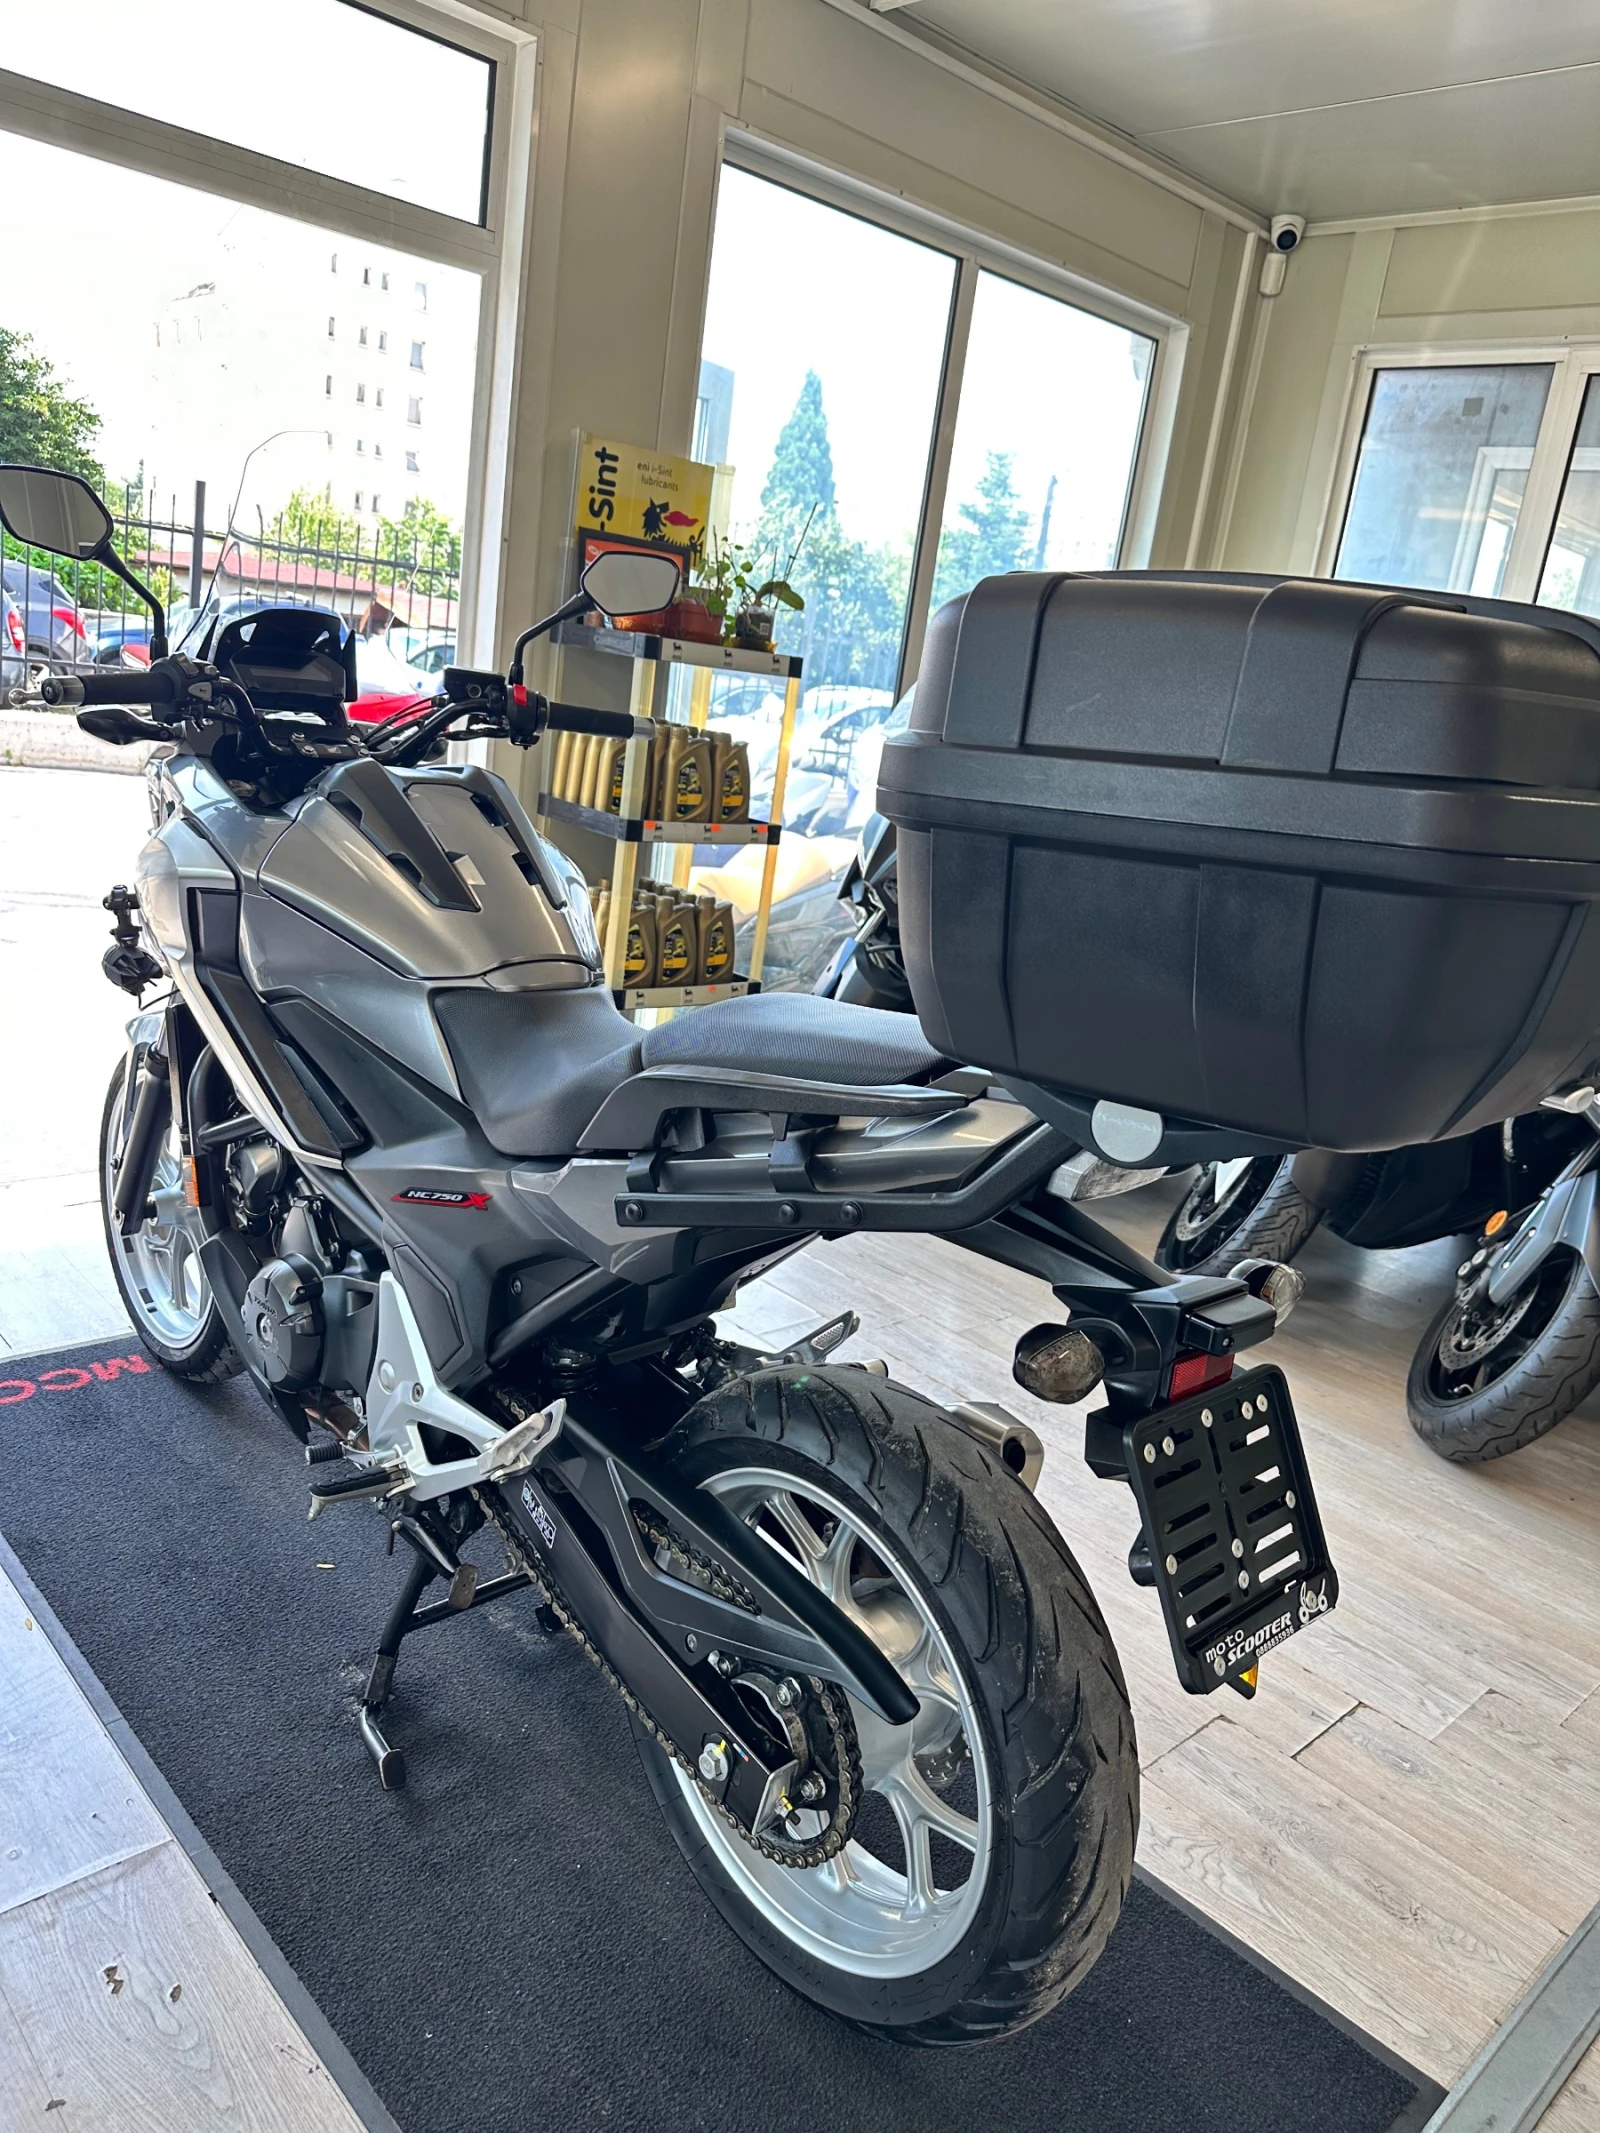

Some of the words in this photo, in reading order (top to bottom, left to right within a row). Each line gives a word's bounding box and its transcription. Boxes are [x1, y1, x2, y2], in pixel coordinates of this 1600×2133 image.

[637, 462, 650, 472] eni
[651, 463, 673, 478] i-Sint
[641, 474, 679, 491] lubricants
[1227, 1611, 1292, 1667] SCOOTER
[1255, 1624, 1295, 1658] 0888835936
